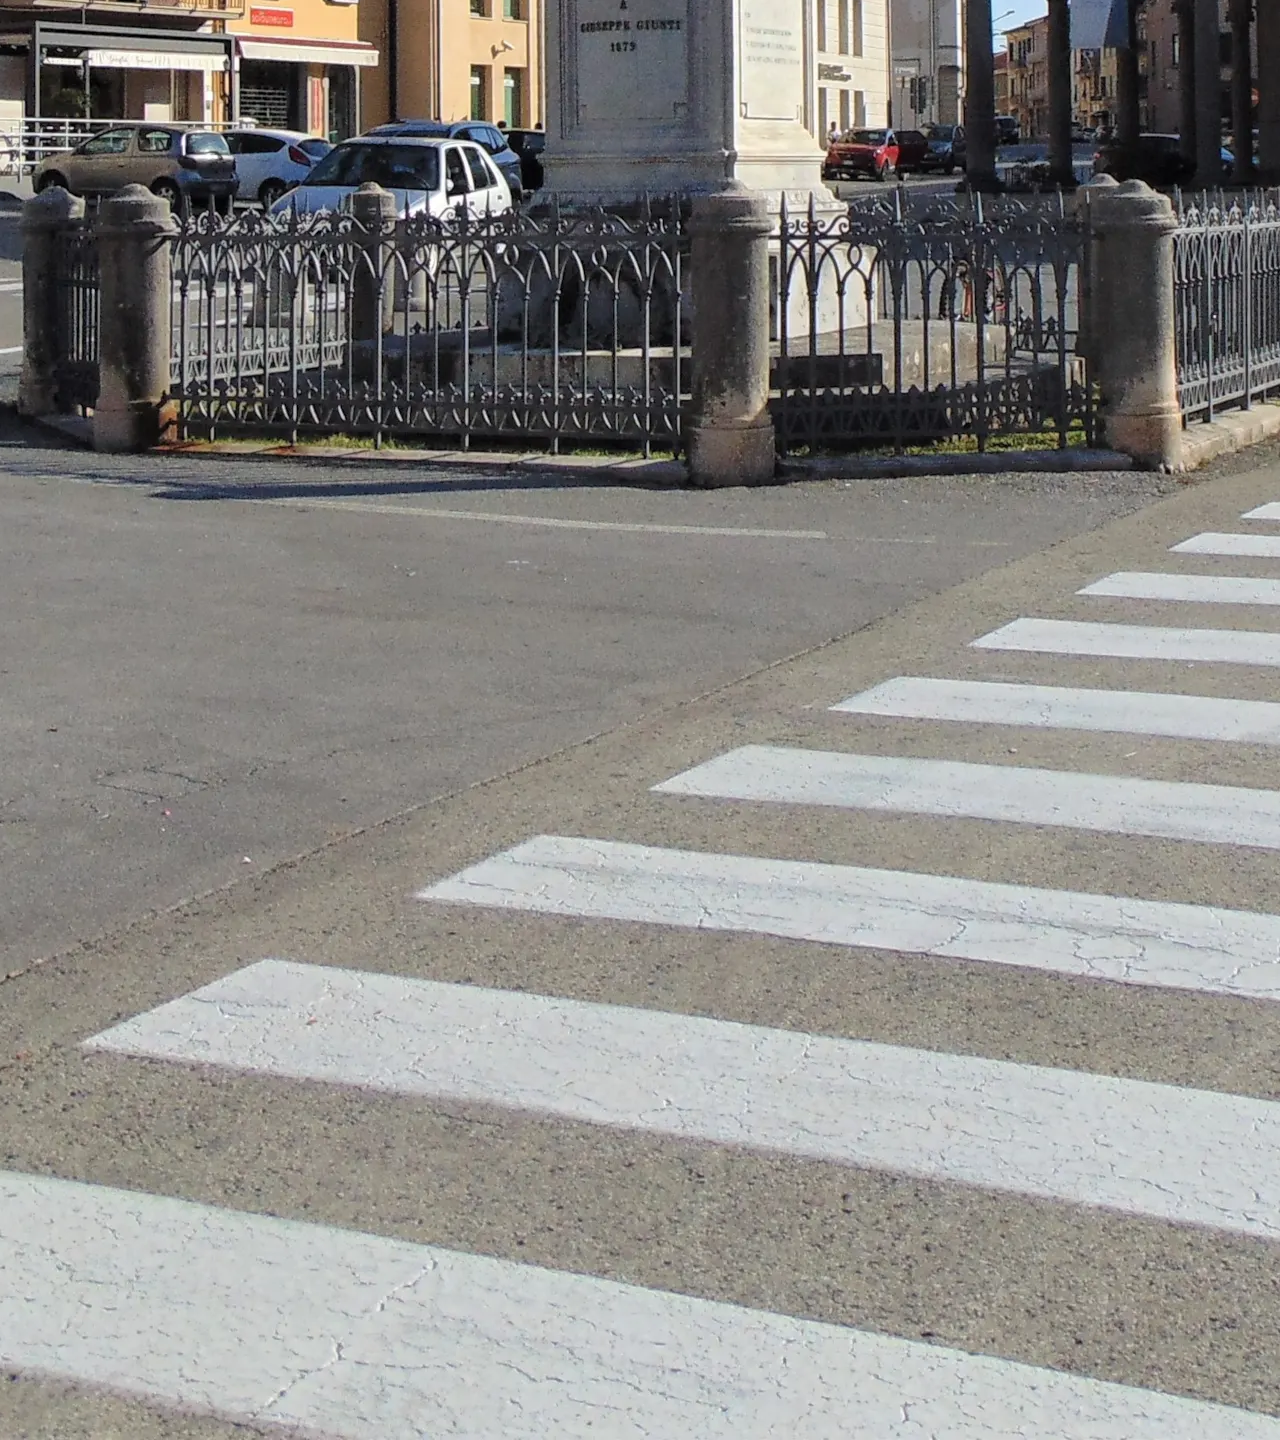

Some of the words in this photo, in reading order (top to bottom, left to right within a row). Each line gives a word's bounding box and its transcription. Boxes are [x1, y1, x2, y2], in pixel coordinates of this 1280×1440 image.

[620, 0, 627, 10] A
[580, 20, 630, 33] GIUSEPPE
[636, 19, 681, 31] GIUSTI
